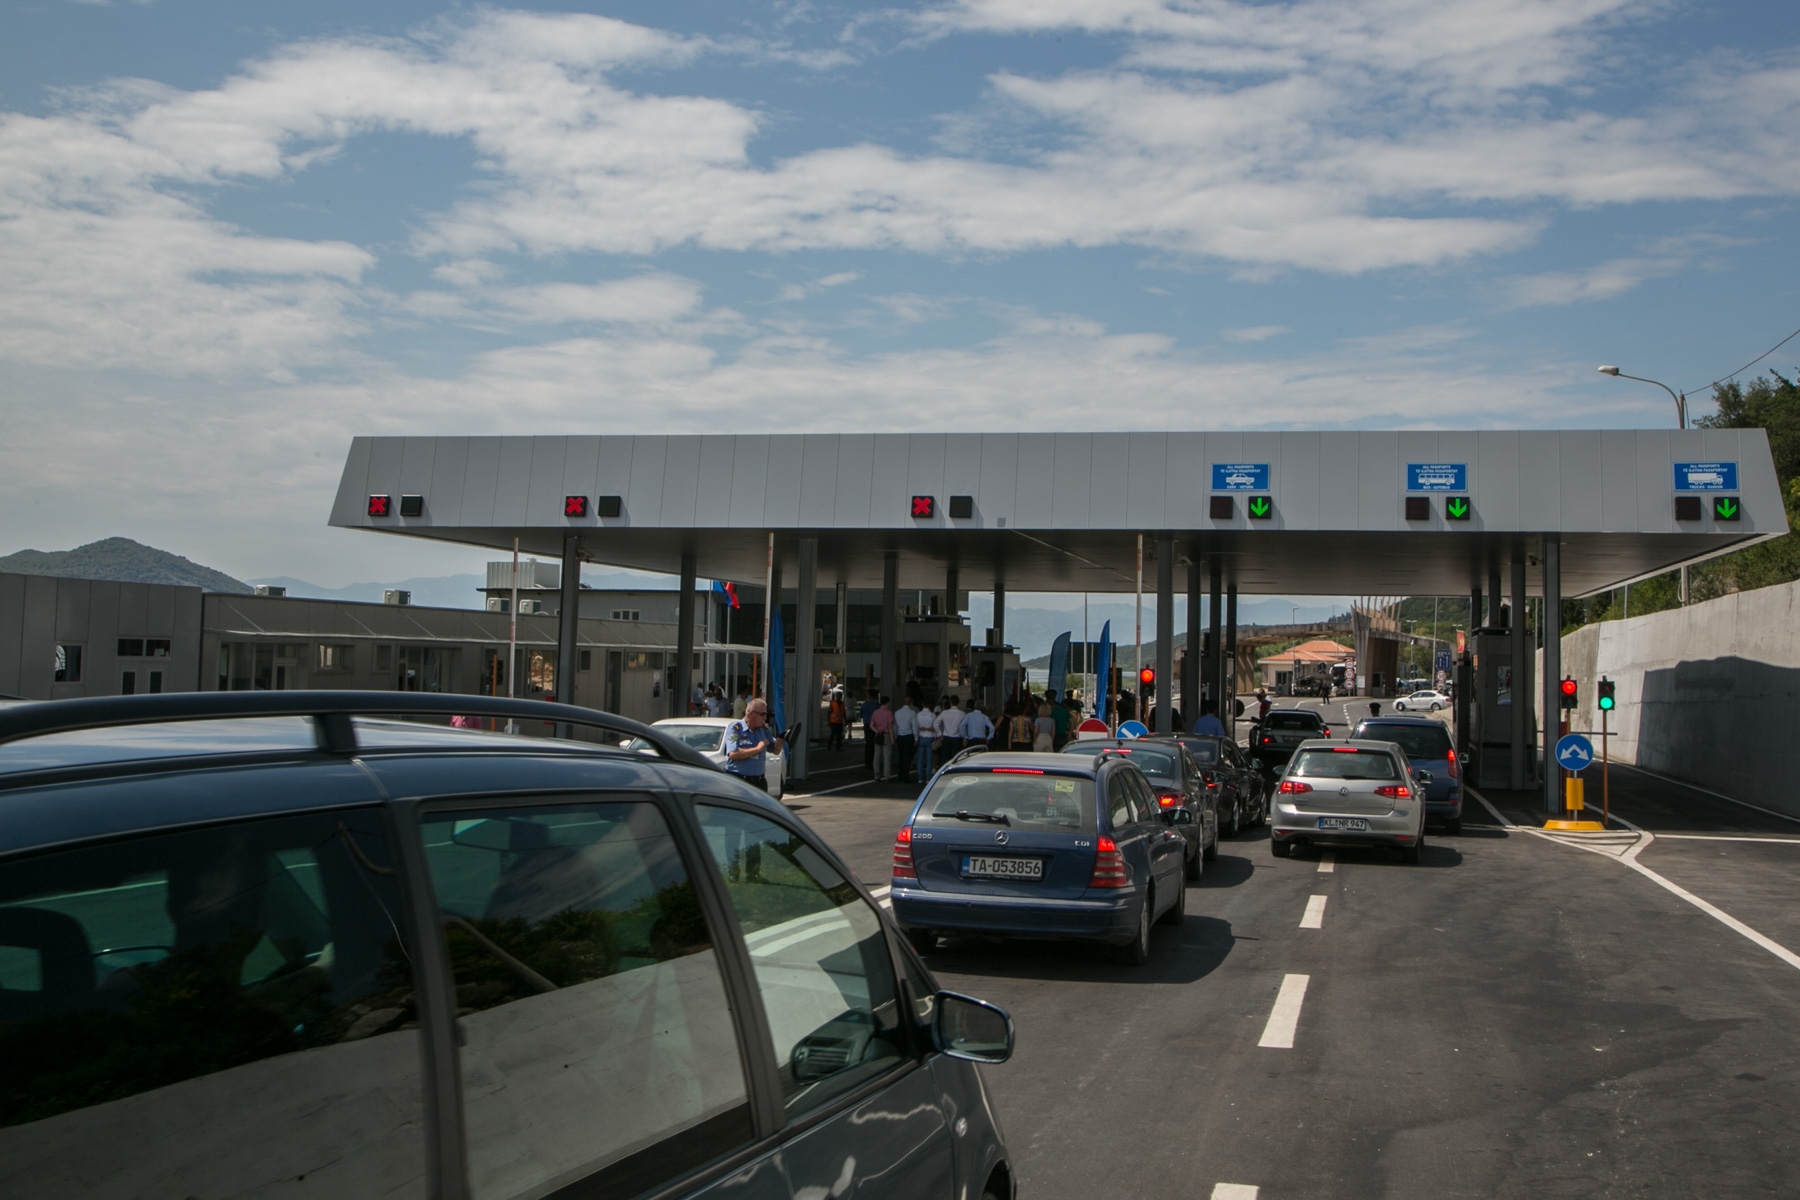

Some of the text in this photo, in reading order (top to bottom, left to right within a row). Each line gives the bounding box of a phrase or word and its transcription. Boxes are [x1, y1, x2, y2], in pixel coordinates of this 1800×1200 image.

[1324, 818, 1334, 826] KL
[1350, 820, 1364, 828] 947
[970, 858, 1041, 875] TA-053856
